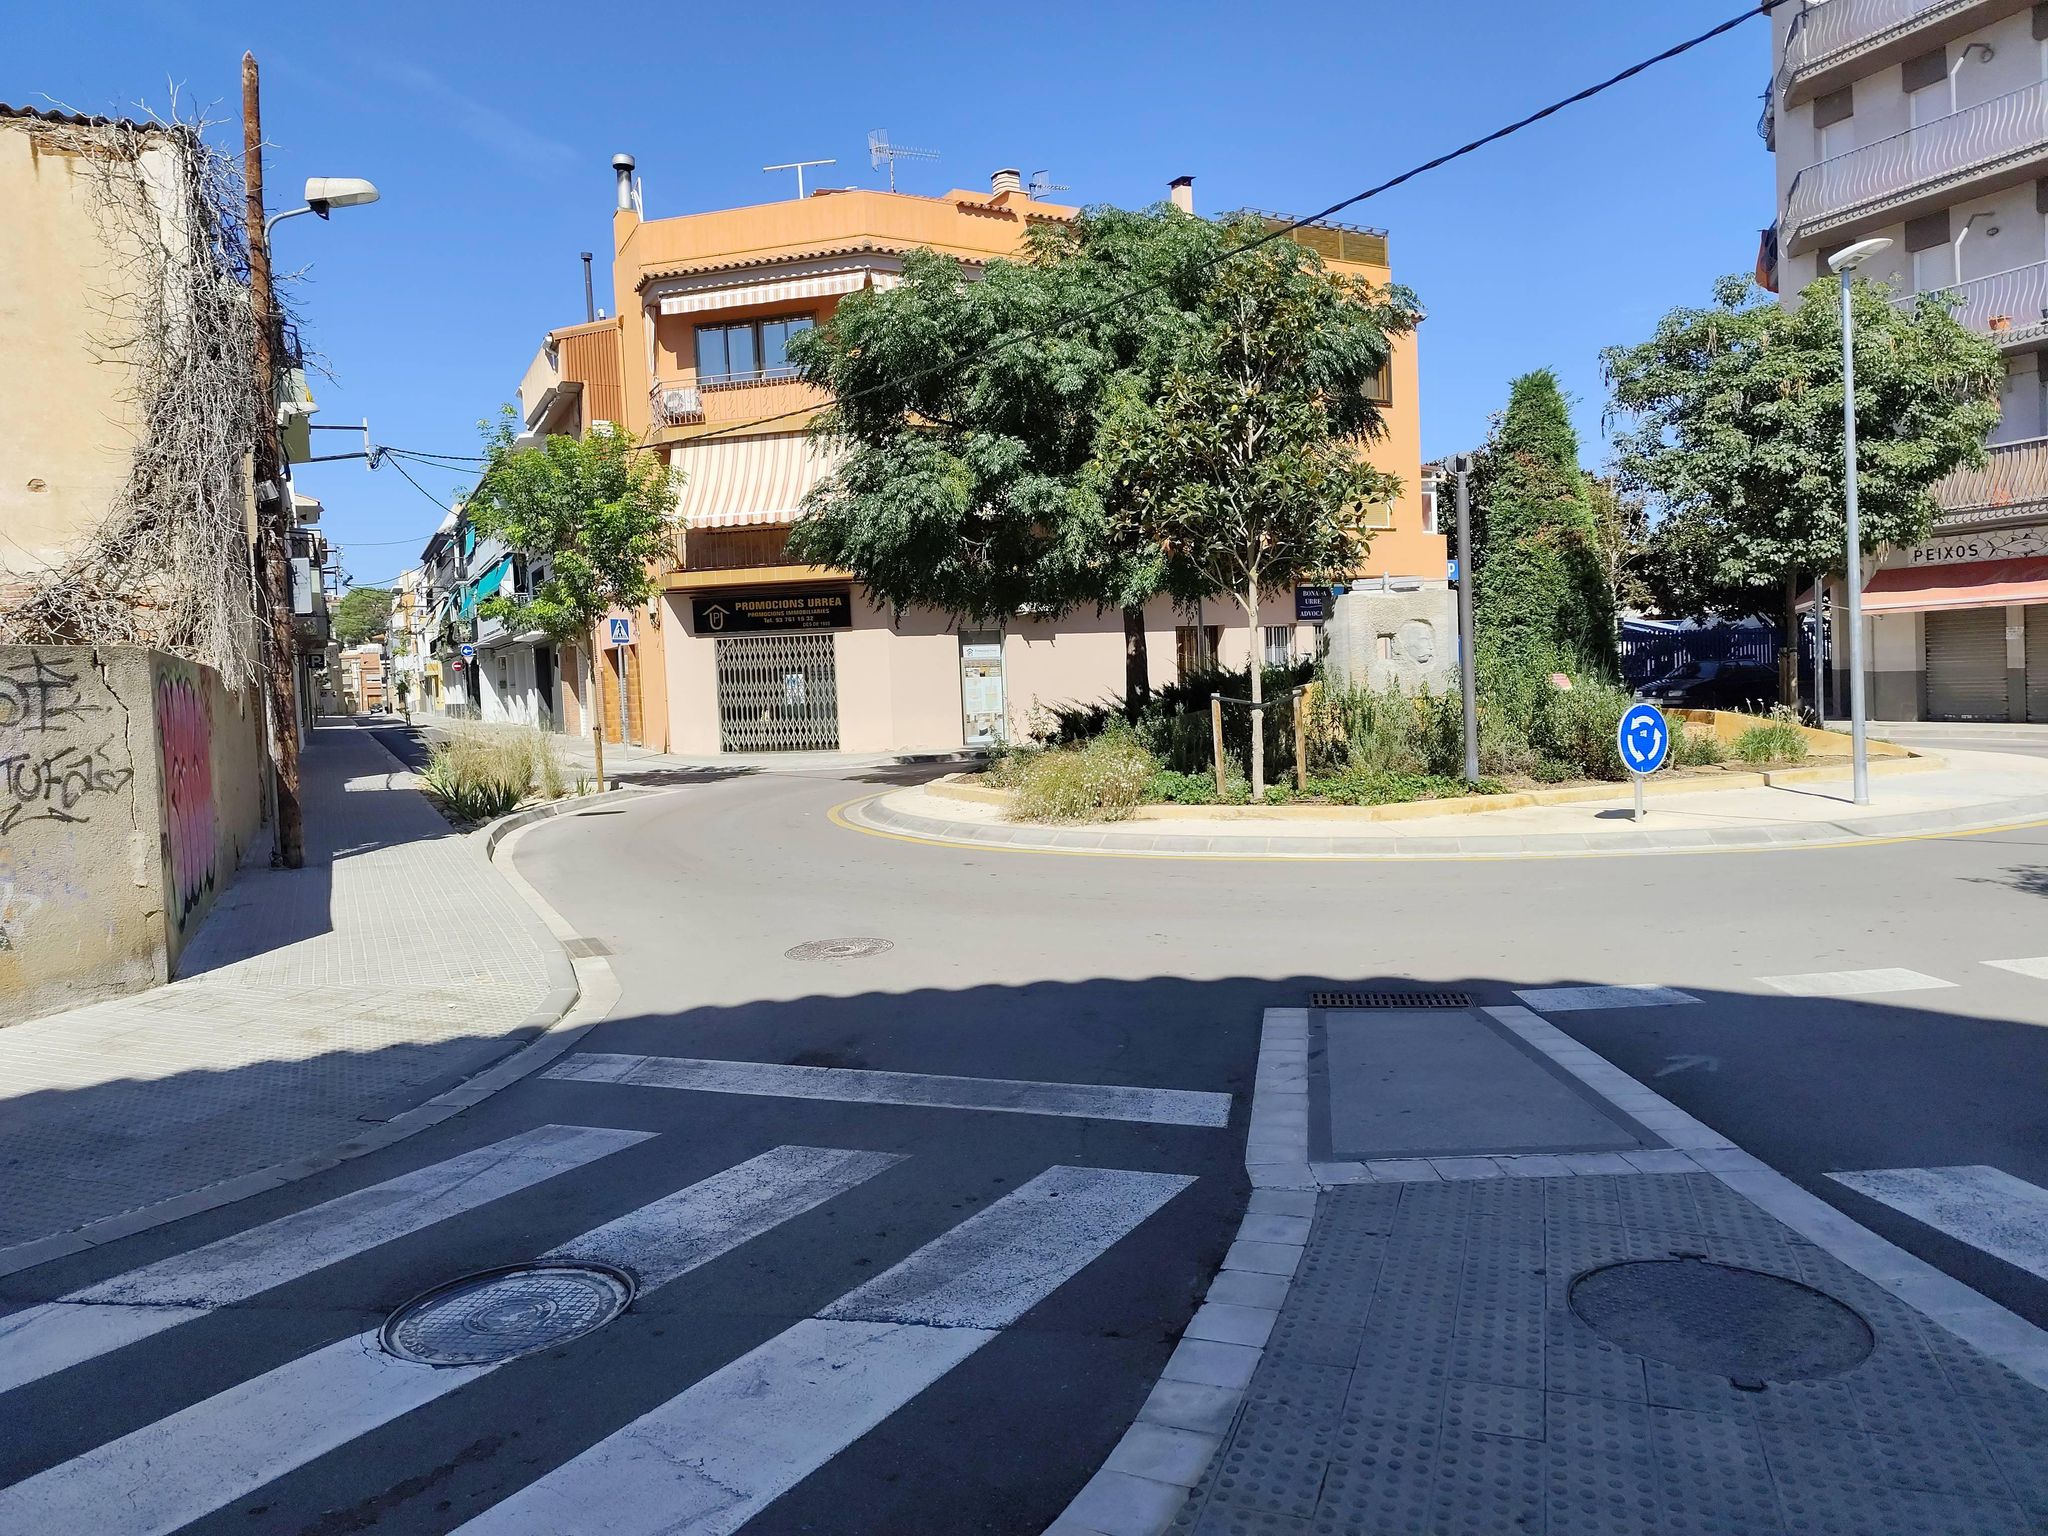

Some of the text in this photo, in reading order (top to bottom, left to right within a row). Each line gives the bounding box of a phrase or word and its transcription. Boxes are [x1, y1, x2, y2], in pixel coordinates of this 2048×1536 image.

[1914, 544, 1978, 562] PEIXOS
[1447, 562, 1456, 578] P
[735, 597, 842, 611] PROMOCIONS URREA
[747, 610, 785, 618] PROMOCIONS
